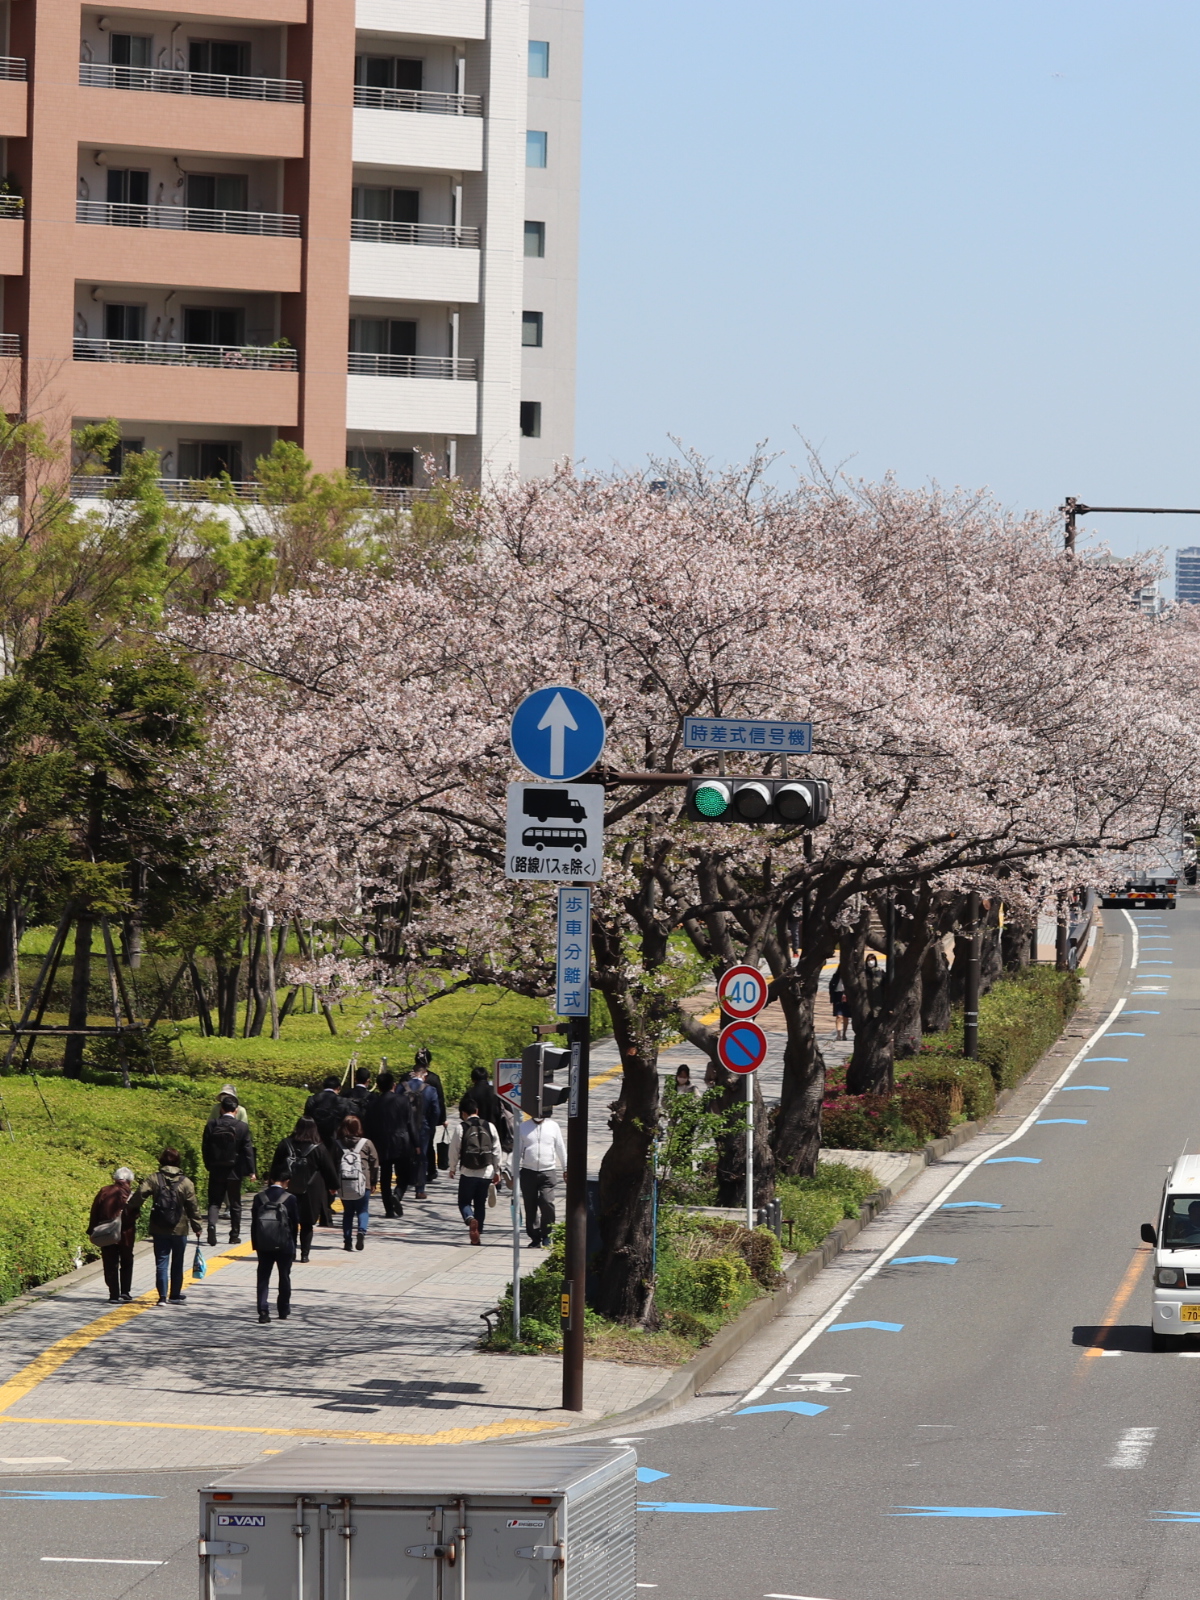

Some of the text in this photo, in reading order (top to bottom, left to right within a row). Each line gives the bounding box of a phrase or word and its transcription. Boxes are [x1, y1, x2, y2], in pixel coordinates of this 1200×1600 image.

[691, 725, 805, 746] 時差式信号機
[510, 856, 597, 876] (路線バスを除く)
[564, 897, 583, 1008] 歩車分離式
[730, 981, 756, 1004] 40
